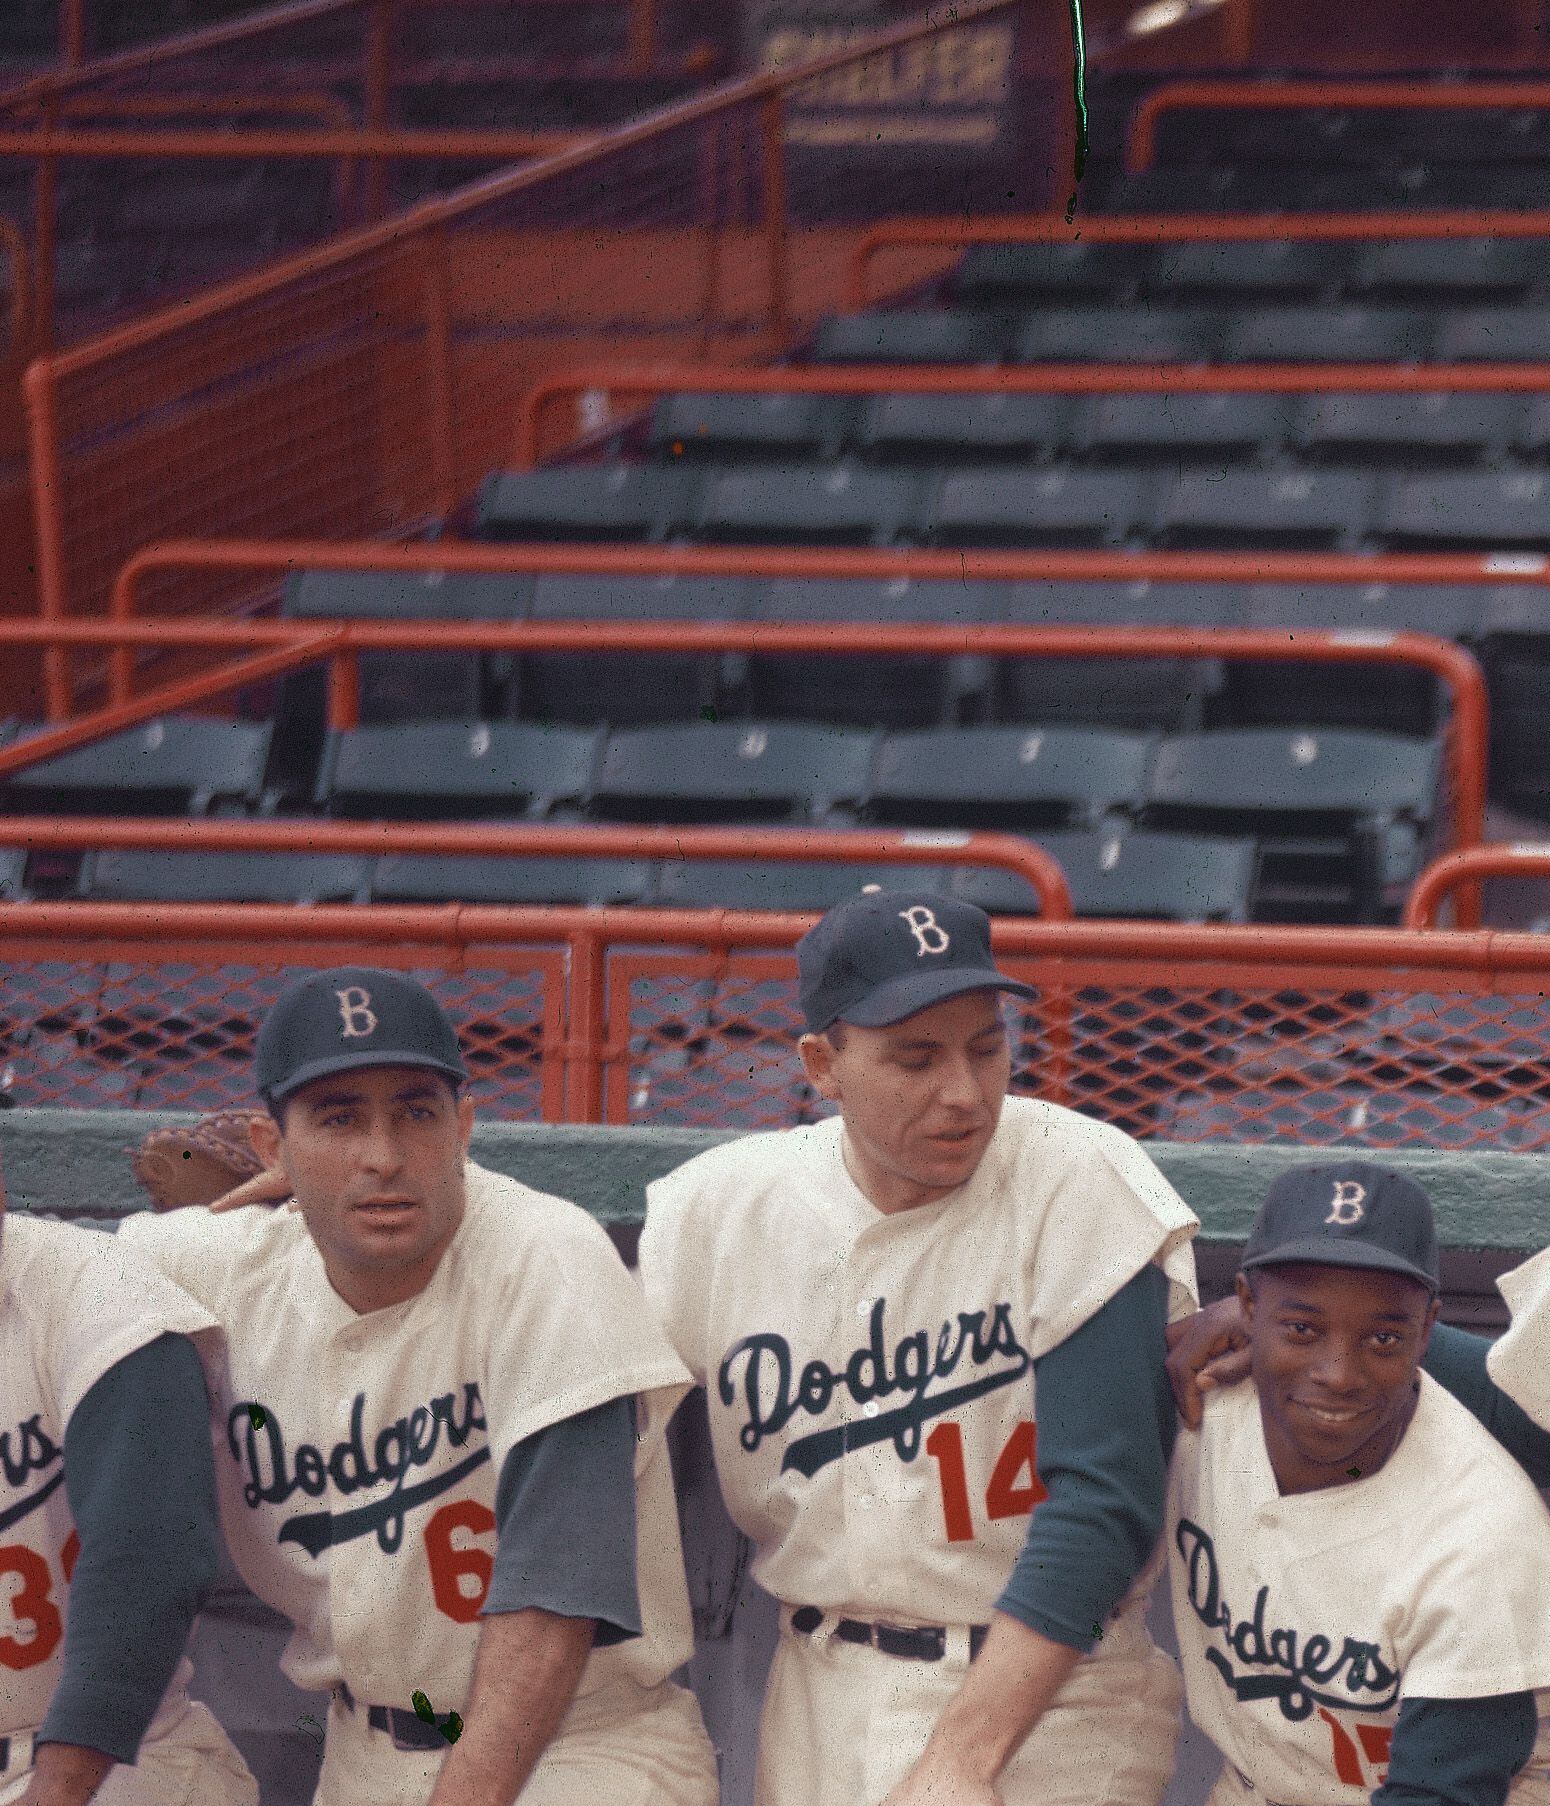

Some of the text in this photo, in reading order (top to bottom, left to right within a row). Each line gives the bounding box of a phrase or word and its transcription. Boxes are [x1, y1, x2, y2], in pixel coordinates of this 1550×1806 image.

[900, 906, 951, 957] B
[335, 987, 379, 1038] B
[1324, 1180, 1367, 1225] B
[718, 1297, 1030, 1463] Dodgers
[423, 1499, 497, 1624] 6
